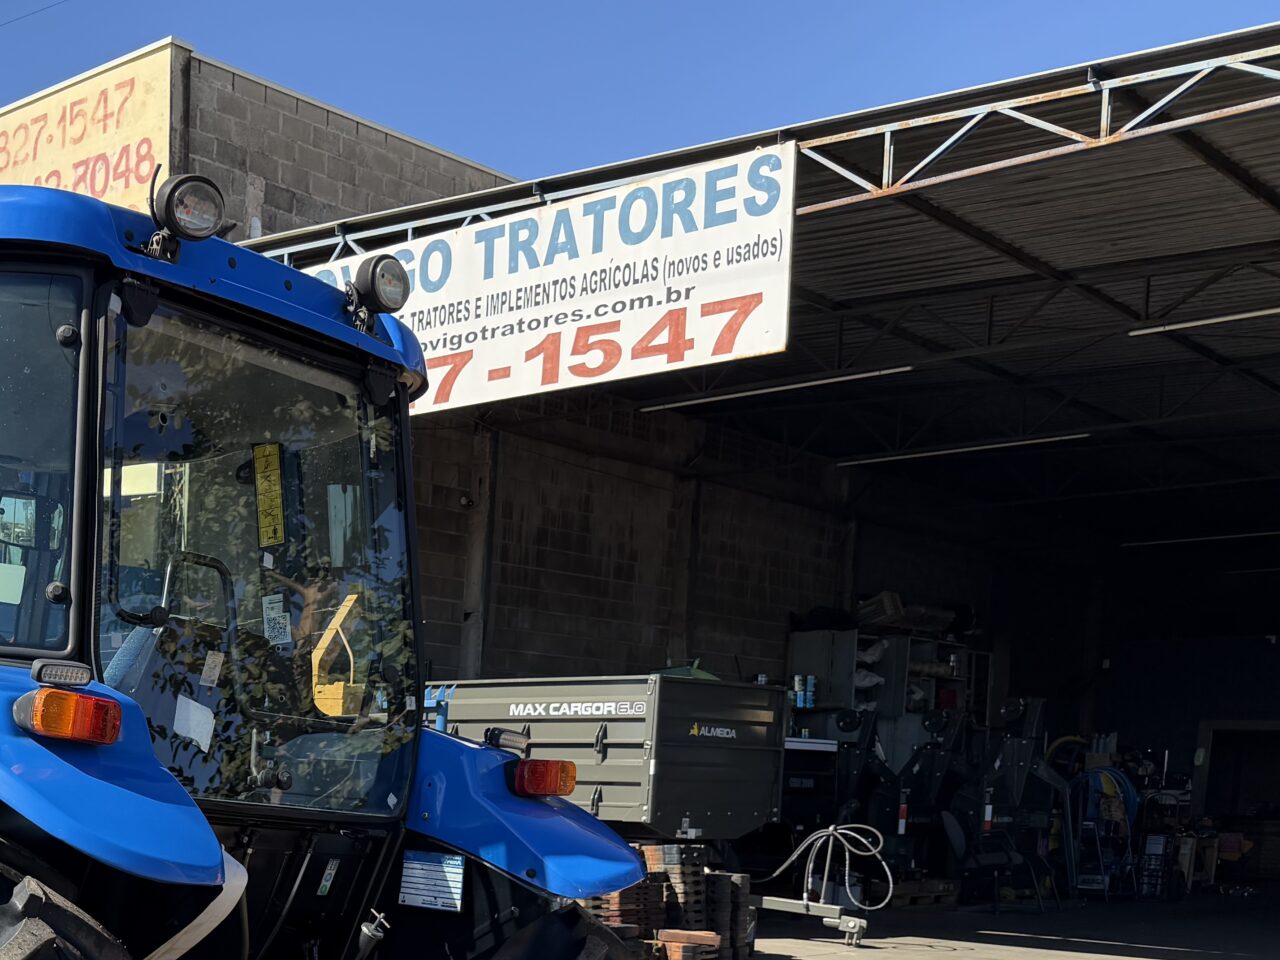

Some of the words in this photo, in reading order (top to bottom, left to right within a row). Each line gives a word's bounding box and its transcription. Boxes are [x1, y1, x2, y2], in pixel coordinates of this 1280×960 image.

[475, 152, 783, 281] TRATORES
[410, 300, 470, 333] TRATORES
[475, 297, 482, 320] E
[486, 275, 575, 321] IMPLEMENTOS
[580, 255, 659, 298] AGRÍCOLAS
[662, 253, 708, 286] (novos
[713, 252, 721, 267] e
[726, 228, 784, 266] usados)
[509, 703, 546, 716] MAX
[549, 701, 616, 716] CARGOR
[616, 701, 646, 715] 6.0
